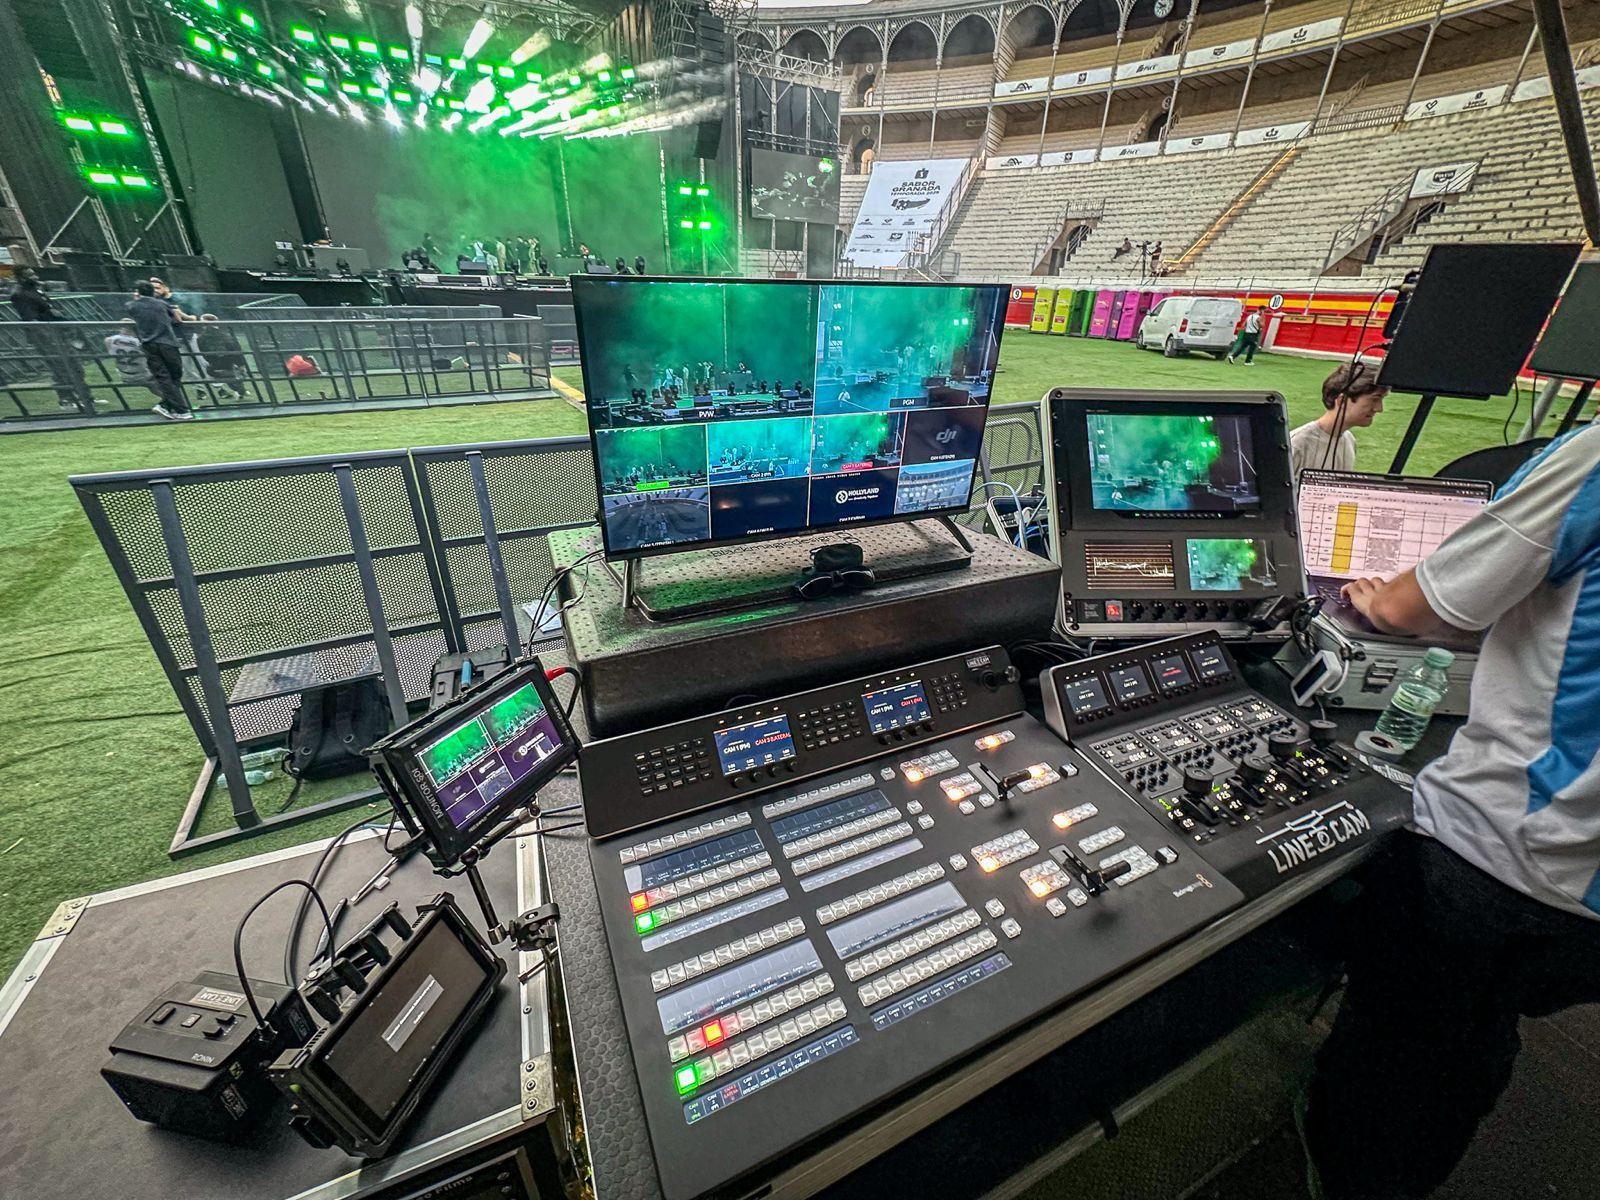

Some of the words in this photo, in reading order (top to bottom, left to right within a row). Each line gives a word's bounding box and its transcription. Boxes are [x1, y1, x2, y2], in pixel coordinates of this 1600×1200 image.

[1271, 296, 1281, 307] 10
[699, 410, 714, 418] PVW
[848, 487, 880, 497] HOLLYLAND
[724, 744, 736, 754] CAM
[412, 767, 425, 783] SDI
[419, 782, 444, 819] MONITOR
[1268, 832, 1318, 873] LINE
[1330, 809, 1371, 843] CAM
[192, 1053, 215, 1064] RONIN
[707, 1093, 717, 1101] CAM
[435, 1176, 473, 1195] Films
